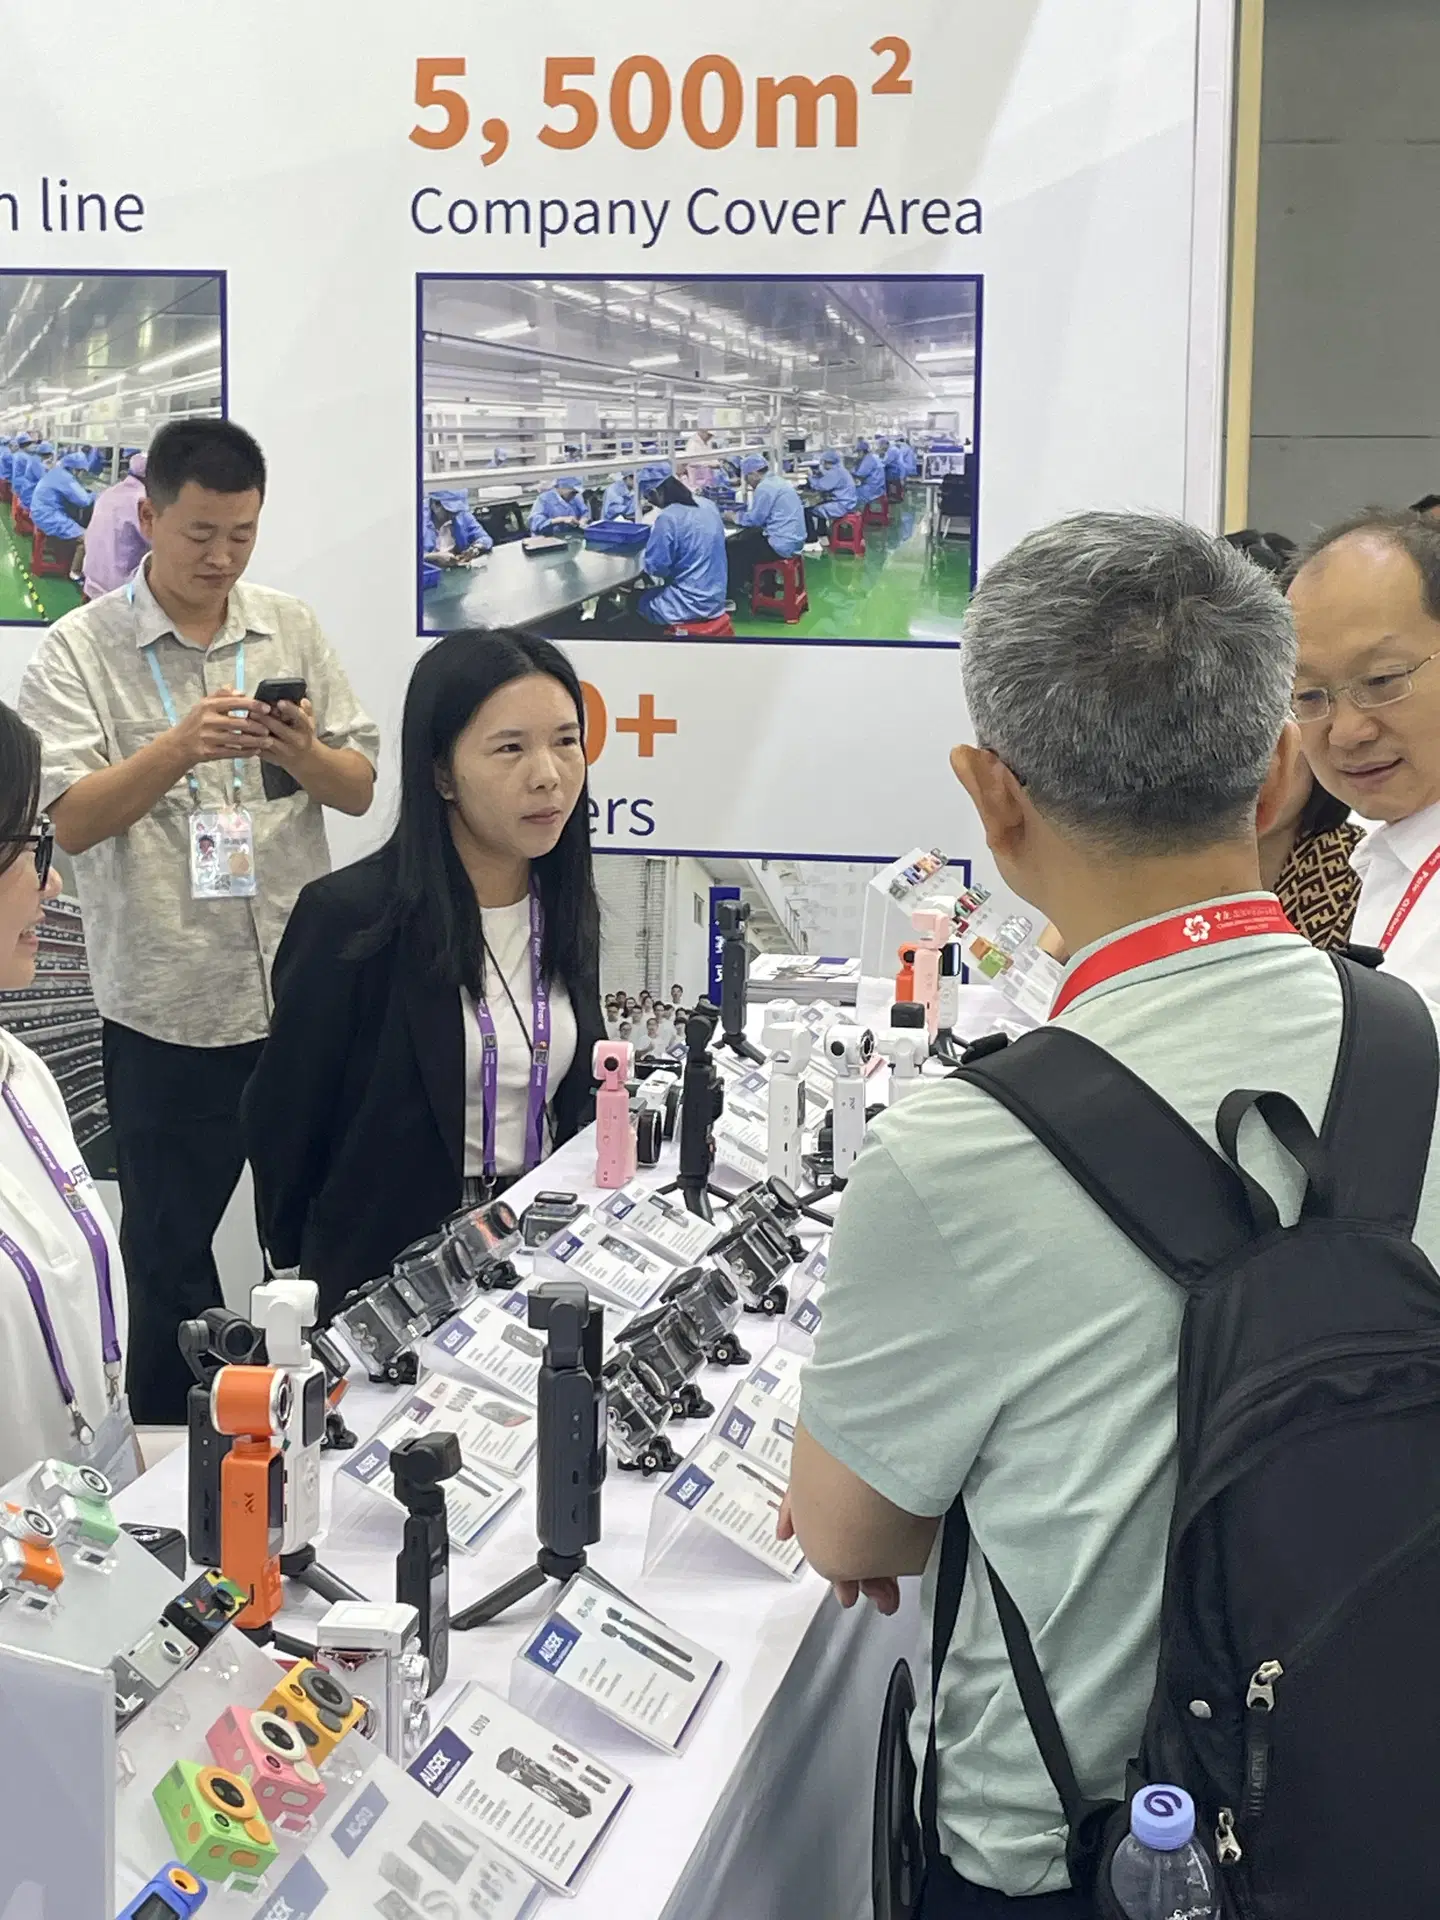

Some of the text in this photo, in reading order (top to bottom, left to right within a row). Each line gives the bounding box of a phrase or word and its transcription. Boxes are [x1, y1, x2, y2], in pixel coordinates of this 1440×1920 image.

[42, 177, 144, 233] line
[411, 187, 982, 249] Company Cover Area
[419, 1749, 451, 1787] AUSEK
